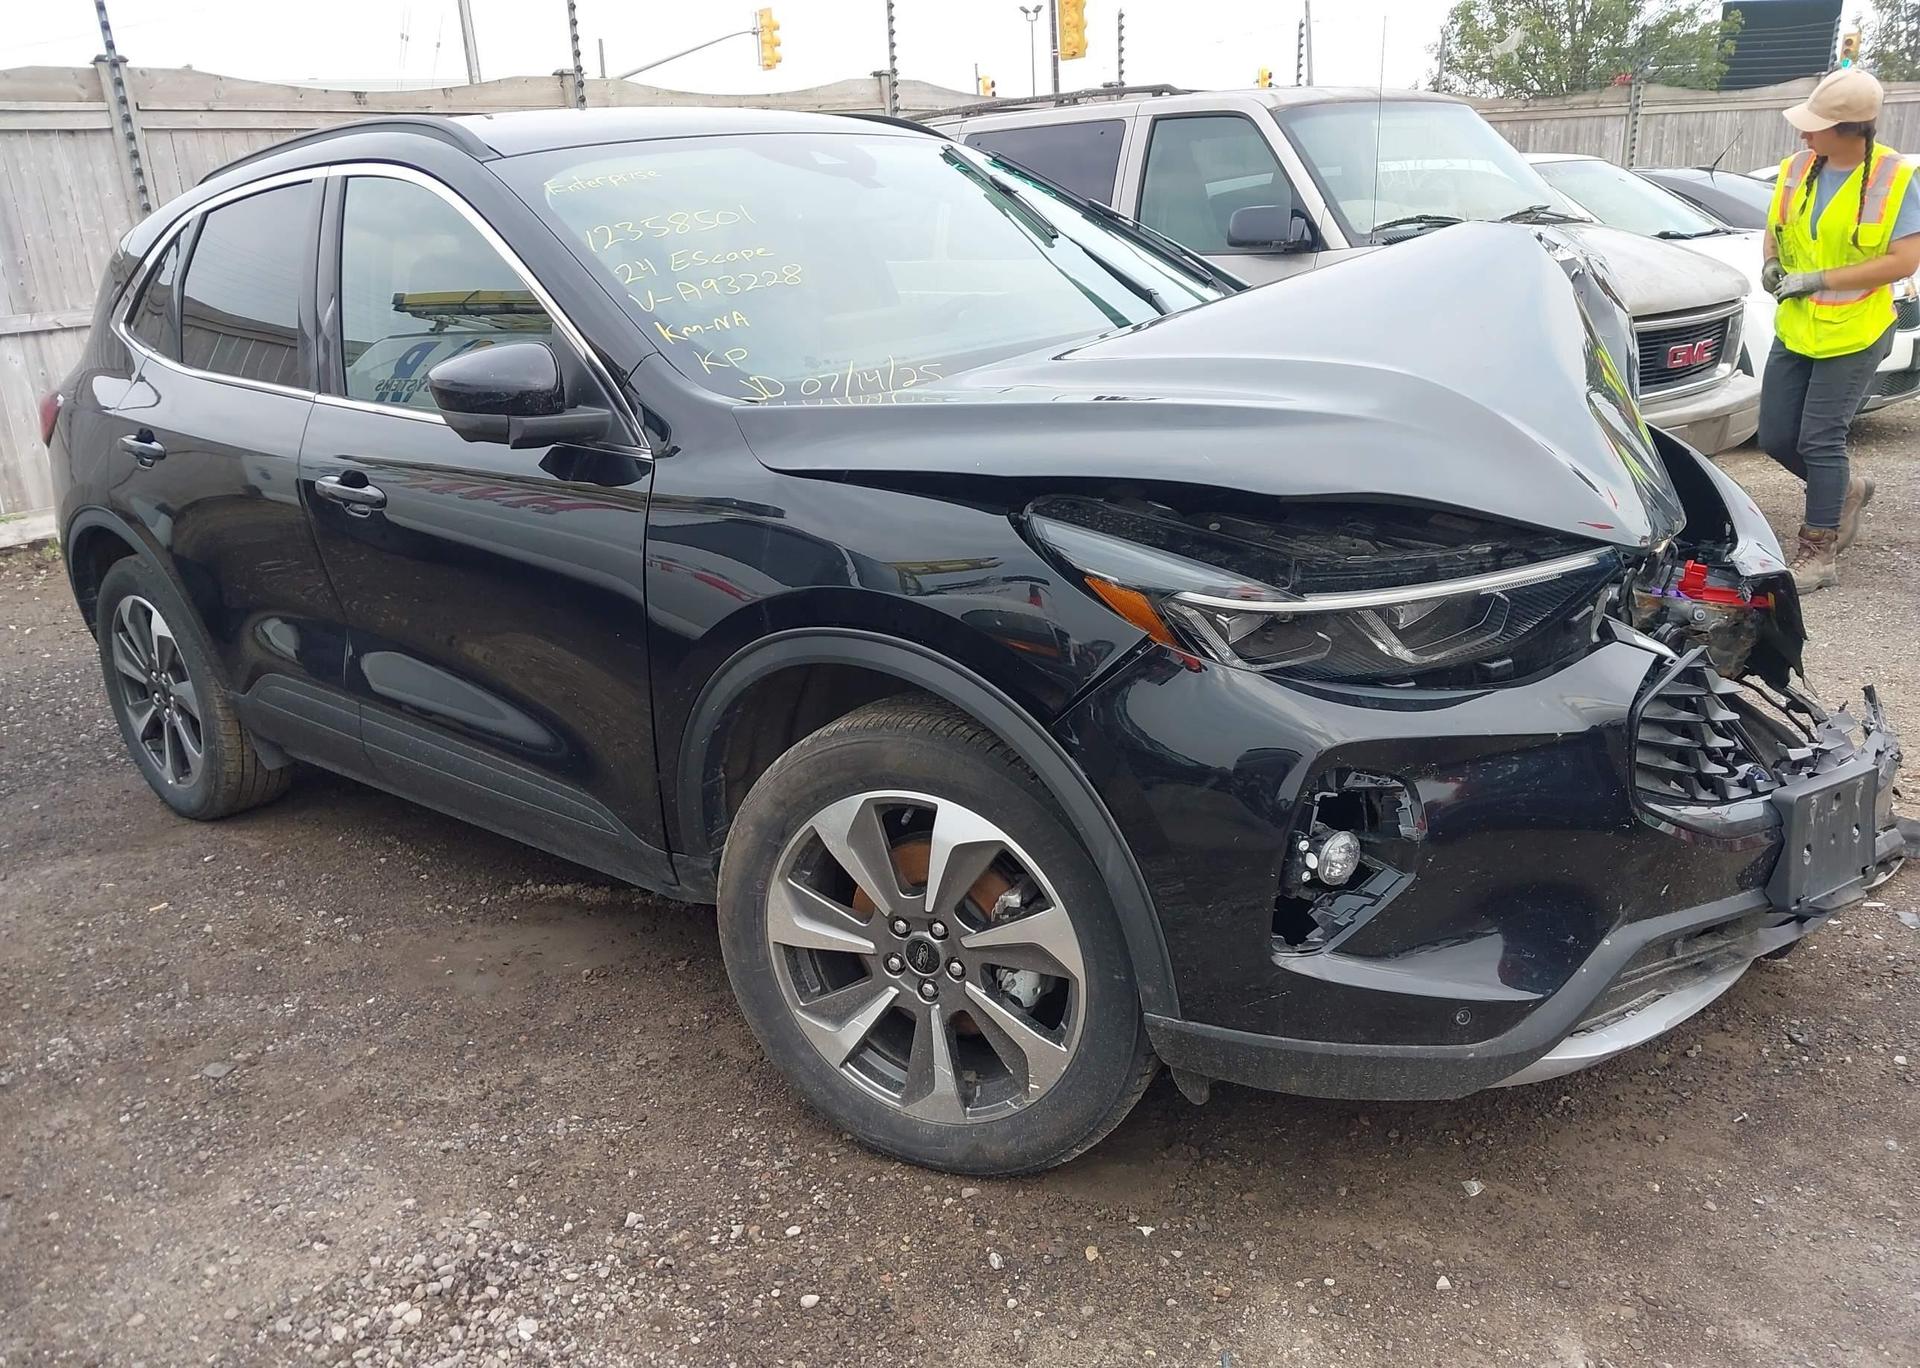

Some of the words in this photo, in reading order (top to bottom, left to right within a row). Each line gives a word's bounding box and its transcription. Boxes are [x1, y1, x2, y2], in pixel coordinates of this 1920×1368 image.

[585, 205, 757, 253] 12358501
[614, 257, 660, 285] 24
[693, 348, 748, 375] KP
[1666, 339, 1713, 369] GMC
[801, 354, 944, 398] 07/14/25
